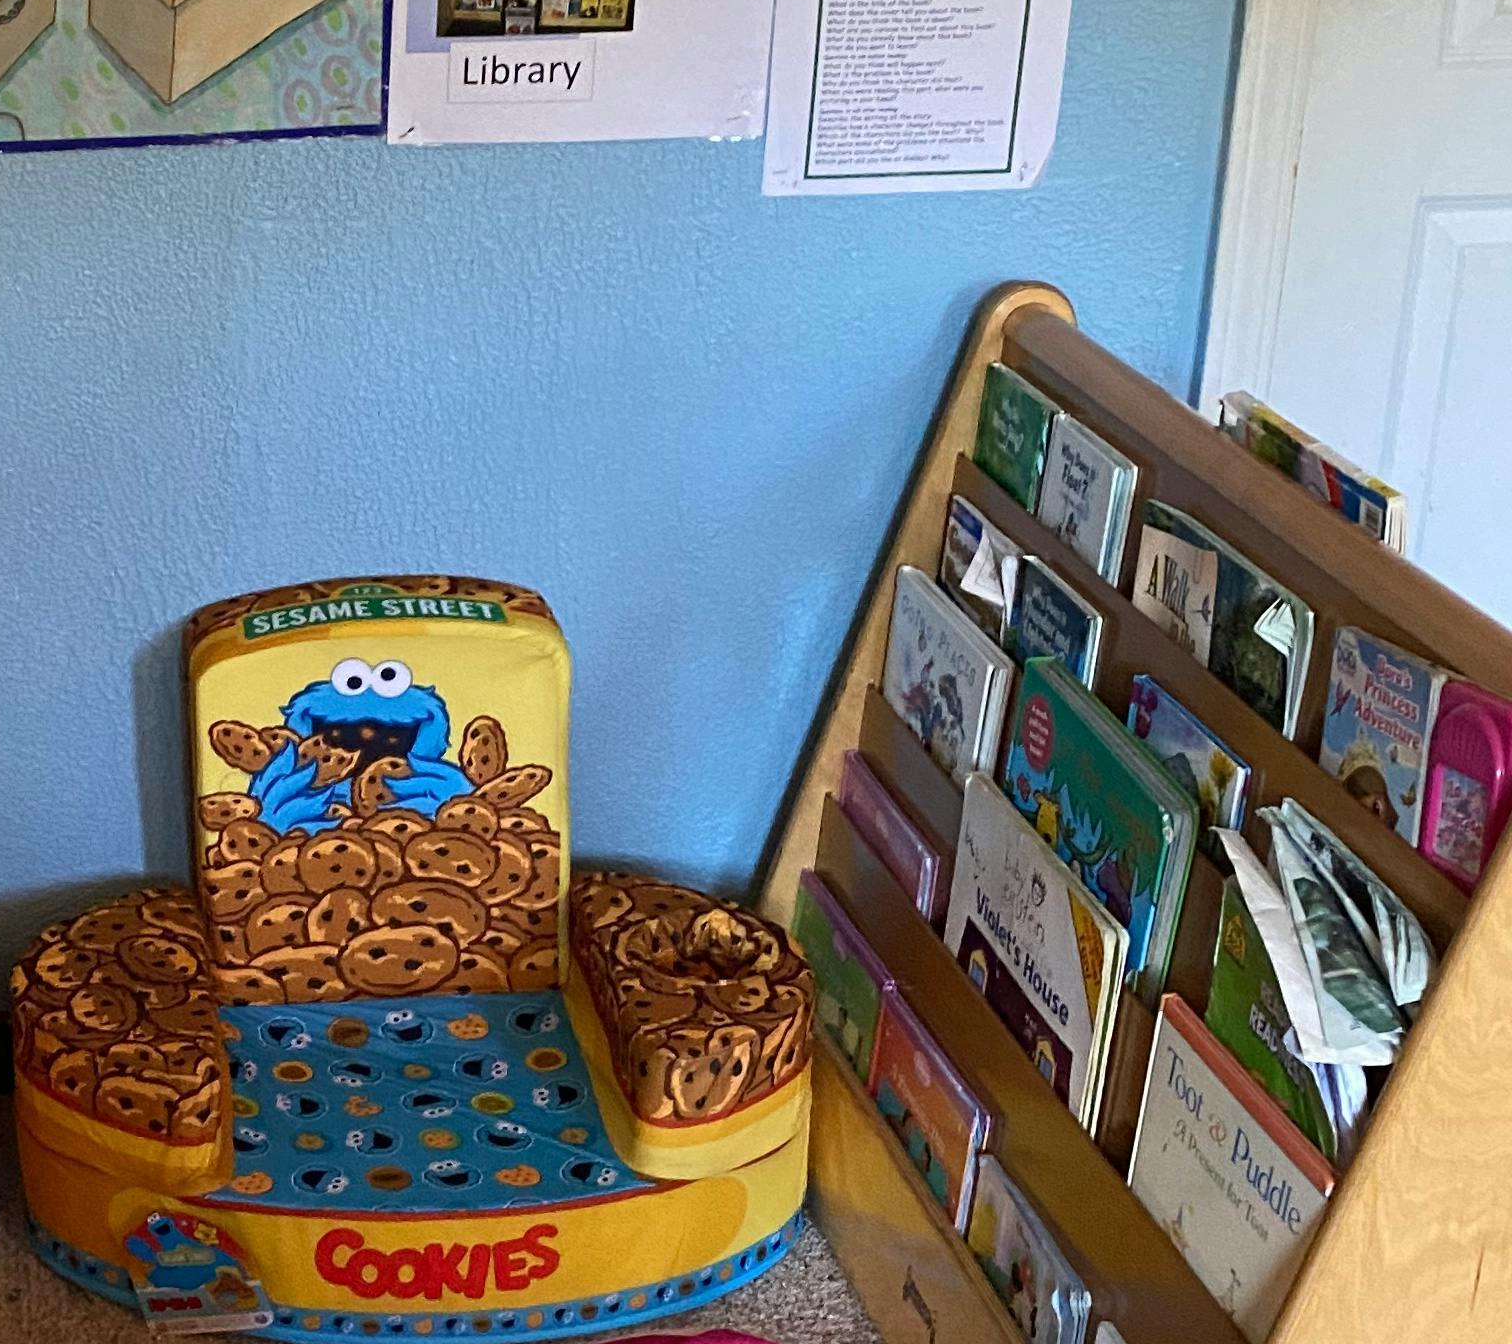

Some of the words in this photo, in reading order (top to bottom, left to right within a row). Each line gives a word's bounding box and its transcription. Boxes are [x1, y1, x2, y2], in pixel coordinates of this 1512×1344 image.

[463, 56, 581, 90] Library
[1145, 554, 1159, 597] A
[251, 599, 371, 635] SESAME
[381, 598, 494, 620] STREET
[1376, 653, 1413, 691] Dora's
[1365, 674, 1419, 722] Princess
[1354, 699, 1422, 751] Adventure
[976, 887, 1021, 967] Violet's
[1023, 952, 1070, 1026] House
[1167, 1045, 1205, 1124] Toot
[1230, 1126, 1302, 1236] Puddle
[314, 1223, 560, 1301] COOKIES
